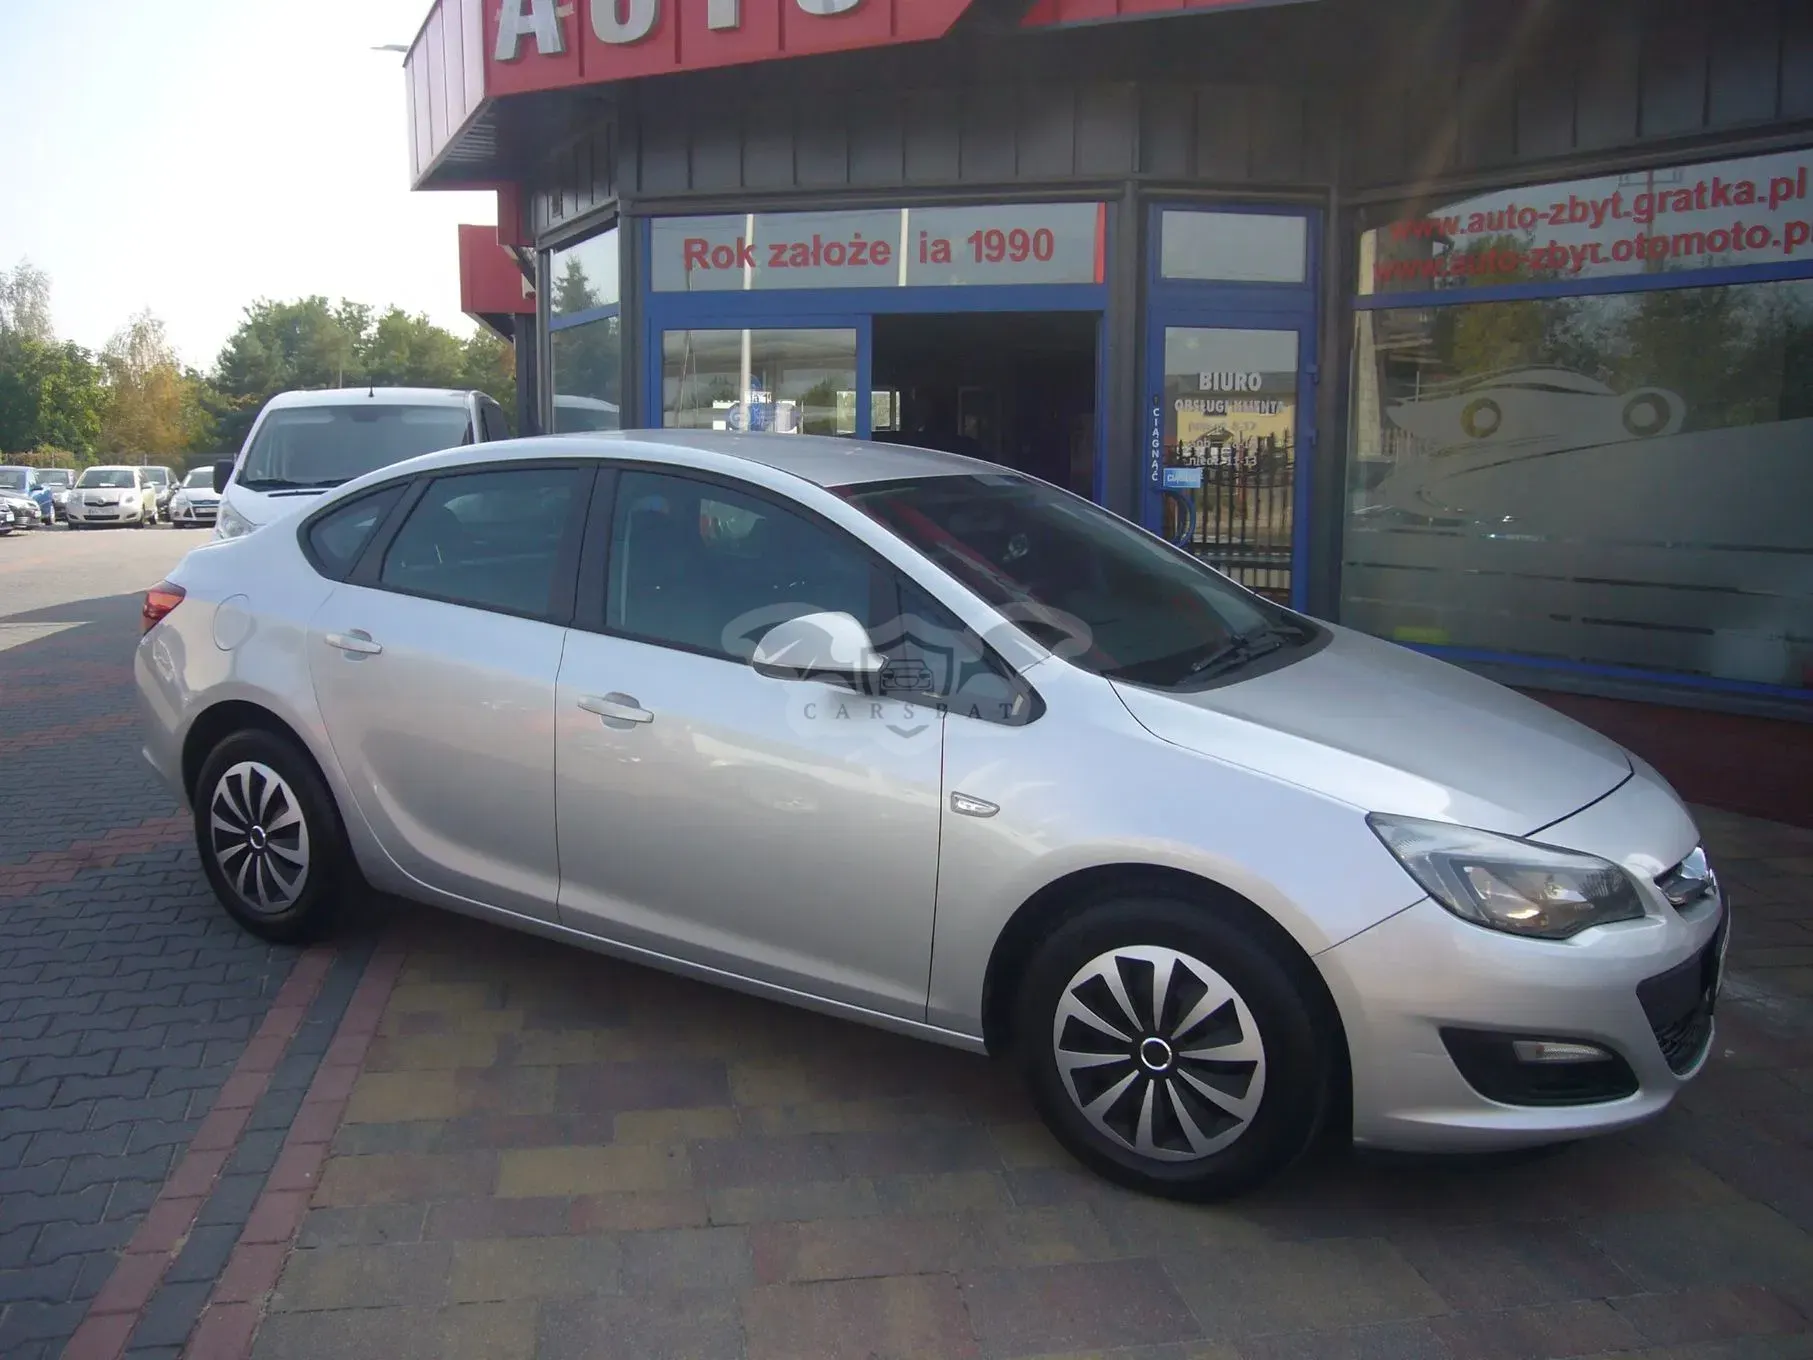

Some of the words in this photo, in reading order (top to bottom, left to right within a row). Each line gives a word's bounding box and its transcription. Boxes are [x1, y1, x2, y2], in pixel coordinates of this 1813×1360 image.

[684, 236, 757, 270] Rok
[967, 228, 1054, 265] 1990
[1373, 219, 1813, 281] www.auto-zbyt.otomoto.p
[1199, 371, 1263, 392] BIURO
